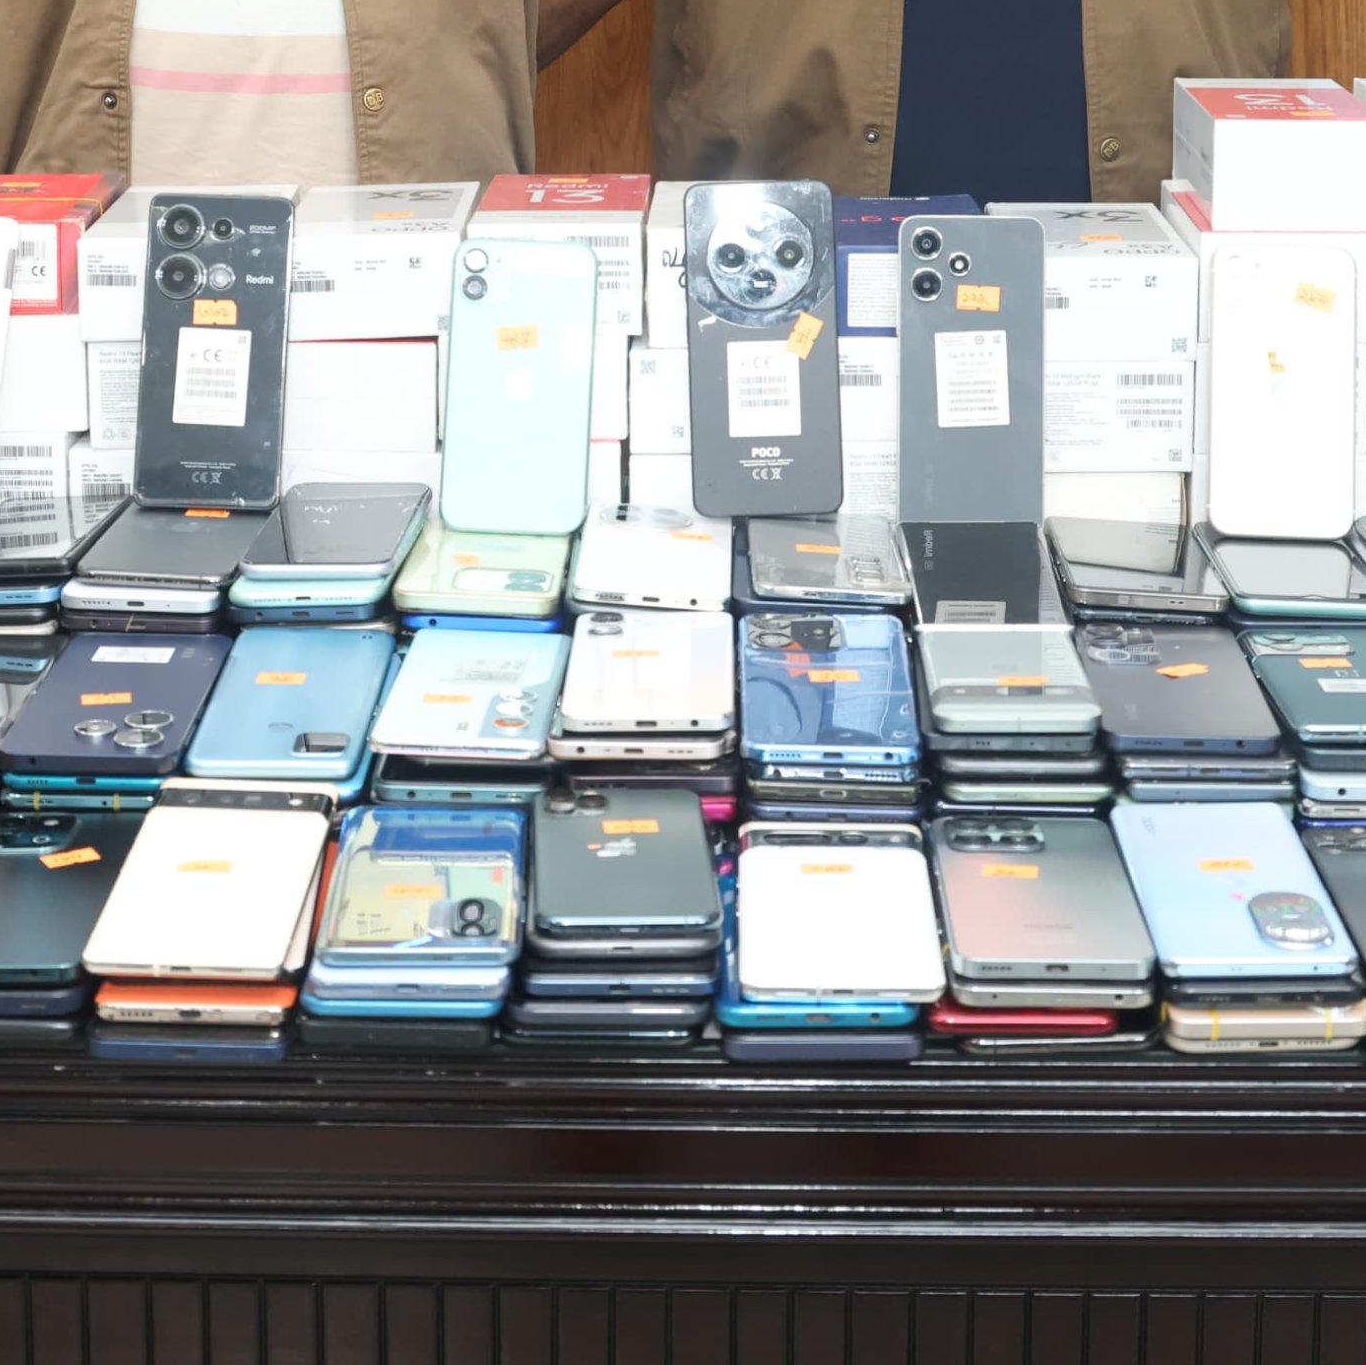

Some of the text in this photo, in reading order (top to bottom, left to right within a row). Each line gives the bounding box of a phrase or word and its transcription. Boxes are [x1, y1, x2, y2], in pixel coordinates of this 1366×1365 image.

[525, 189, 605, 204] 13
[245, 274, 274, 285] Redmi
[751, 447, 781, 458] POCO
